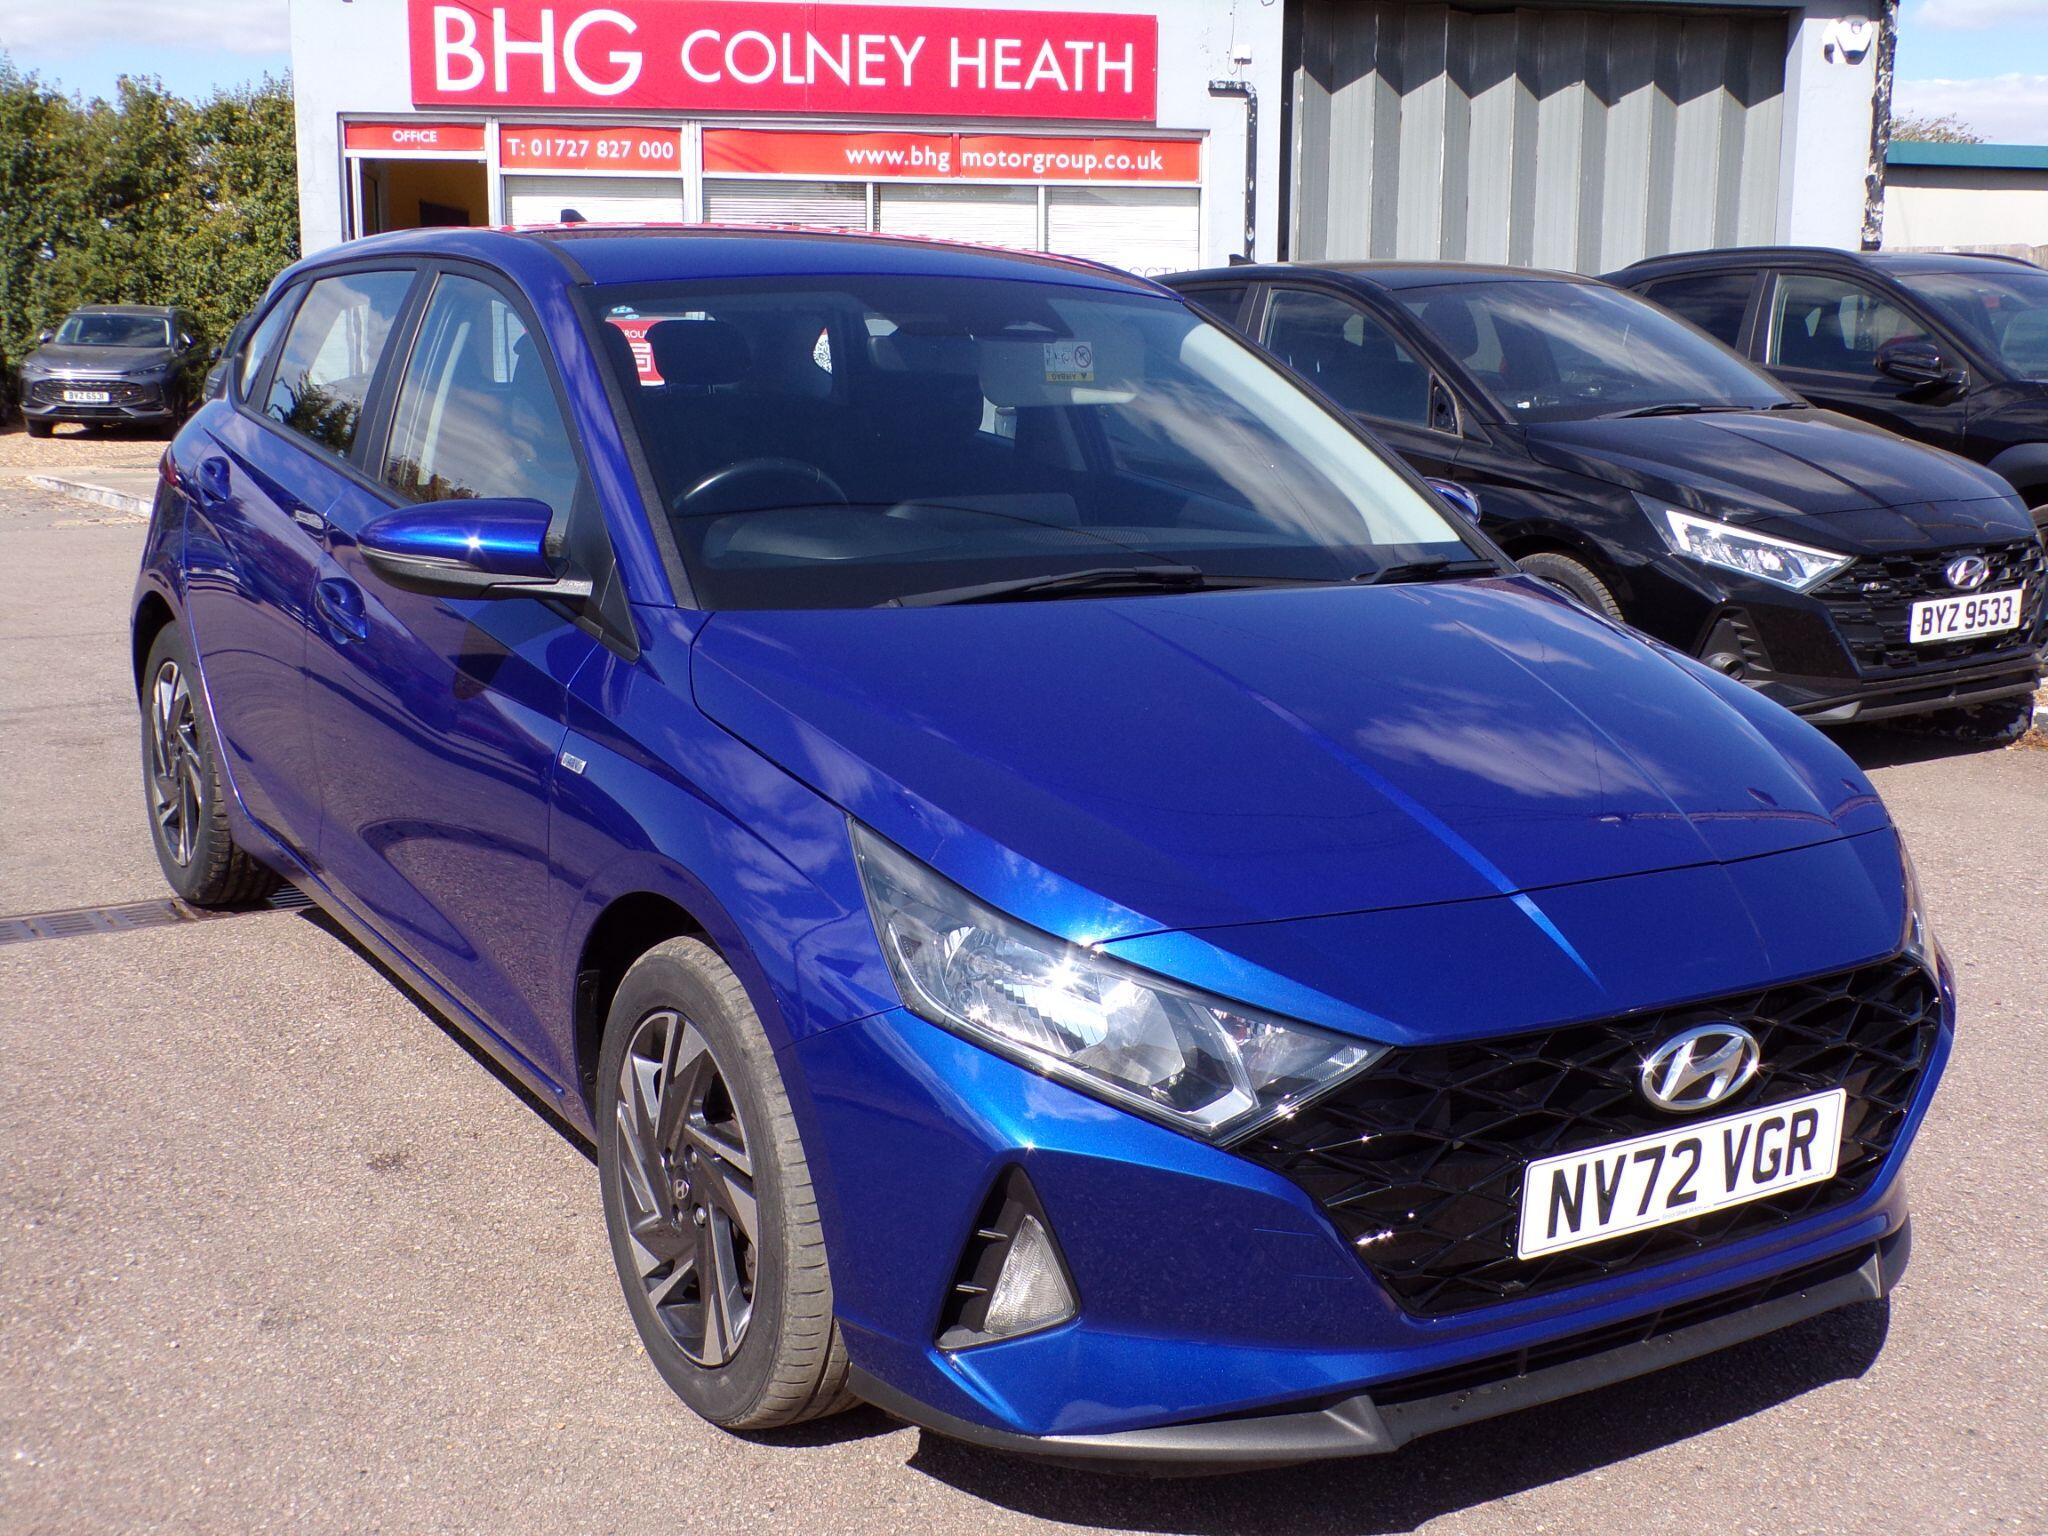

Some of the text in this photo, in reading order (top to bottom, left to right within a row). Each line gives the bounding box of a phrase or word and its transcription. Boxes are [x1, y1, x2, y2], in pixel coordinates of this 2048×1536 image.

[433, 5, 1133, 96] BHG COLNEY HEATH
[392, 130, 438, 143] OFFICE
[506, 138, 674, 159] T: 01727 827 000
[622, 329, 648, 338] ROU
[1920, 596, 2013, 636] BYZ 9533
[1546, 1107, 1820, 1240] NV72 VGR
